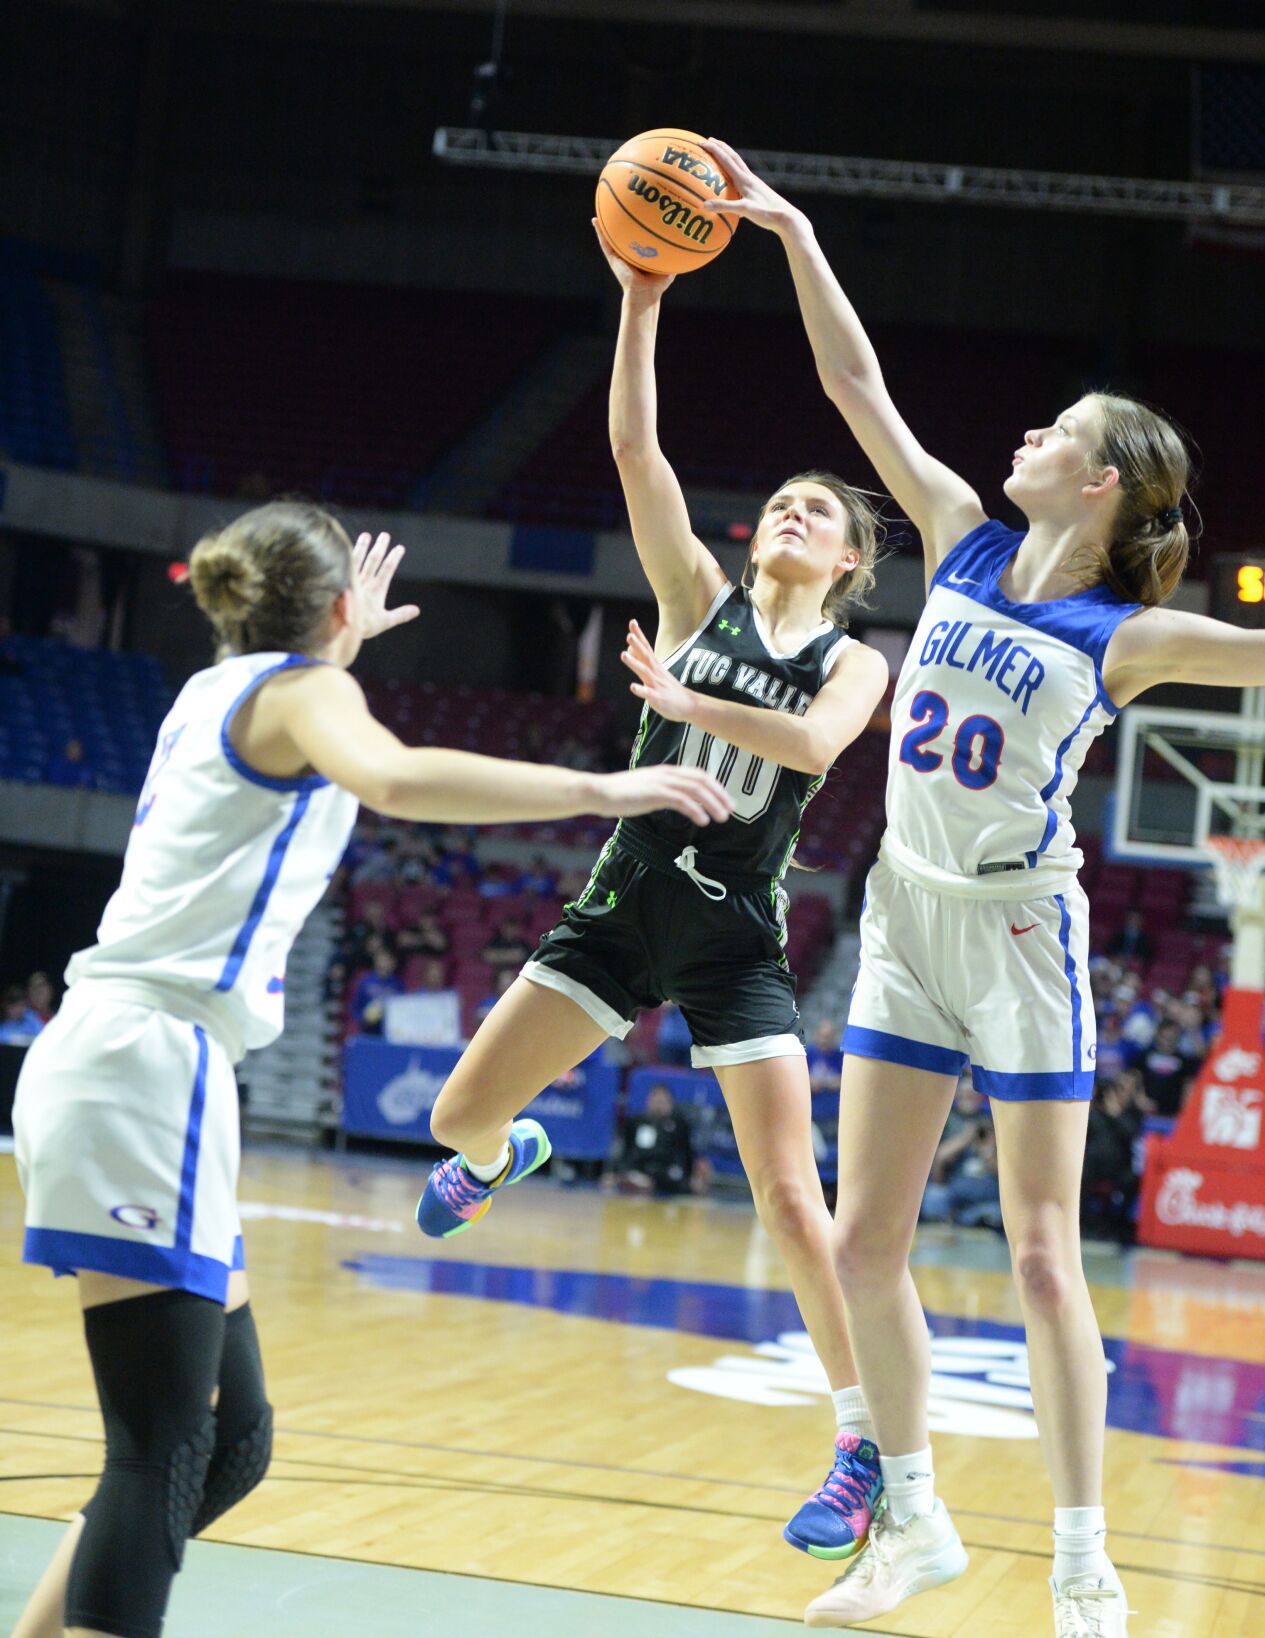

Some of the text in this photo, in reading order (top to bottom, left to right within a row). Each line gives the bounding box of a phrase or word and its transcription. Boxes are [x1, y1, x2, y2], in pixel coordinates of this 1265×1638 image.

[662, 146, 728, 196] NCAA
[628, 174, 714, 245] Wilson
[1237, 565, 1265, 603] 5
[679, 647, 814, 717] TUG VALLE
[919, 620, 1045, 716] GILMER
[899, 689, 1005, 791] 20
[109, 1203, 162, 1230] G
